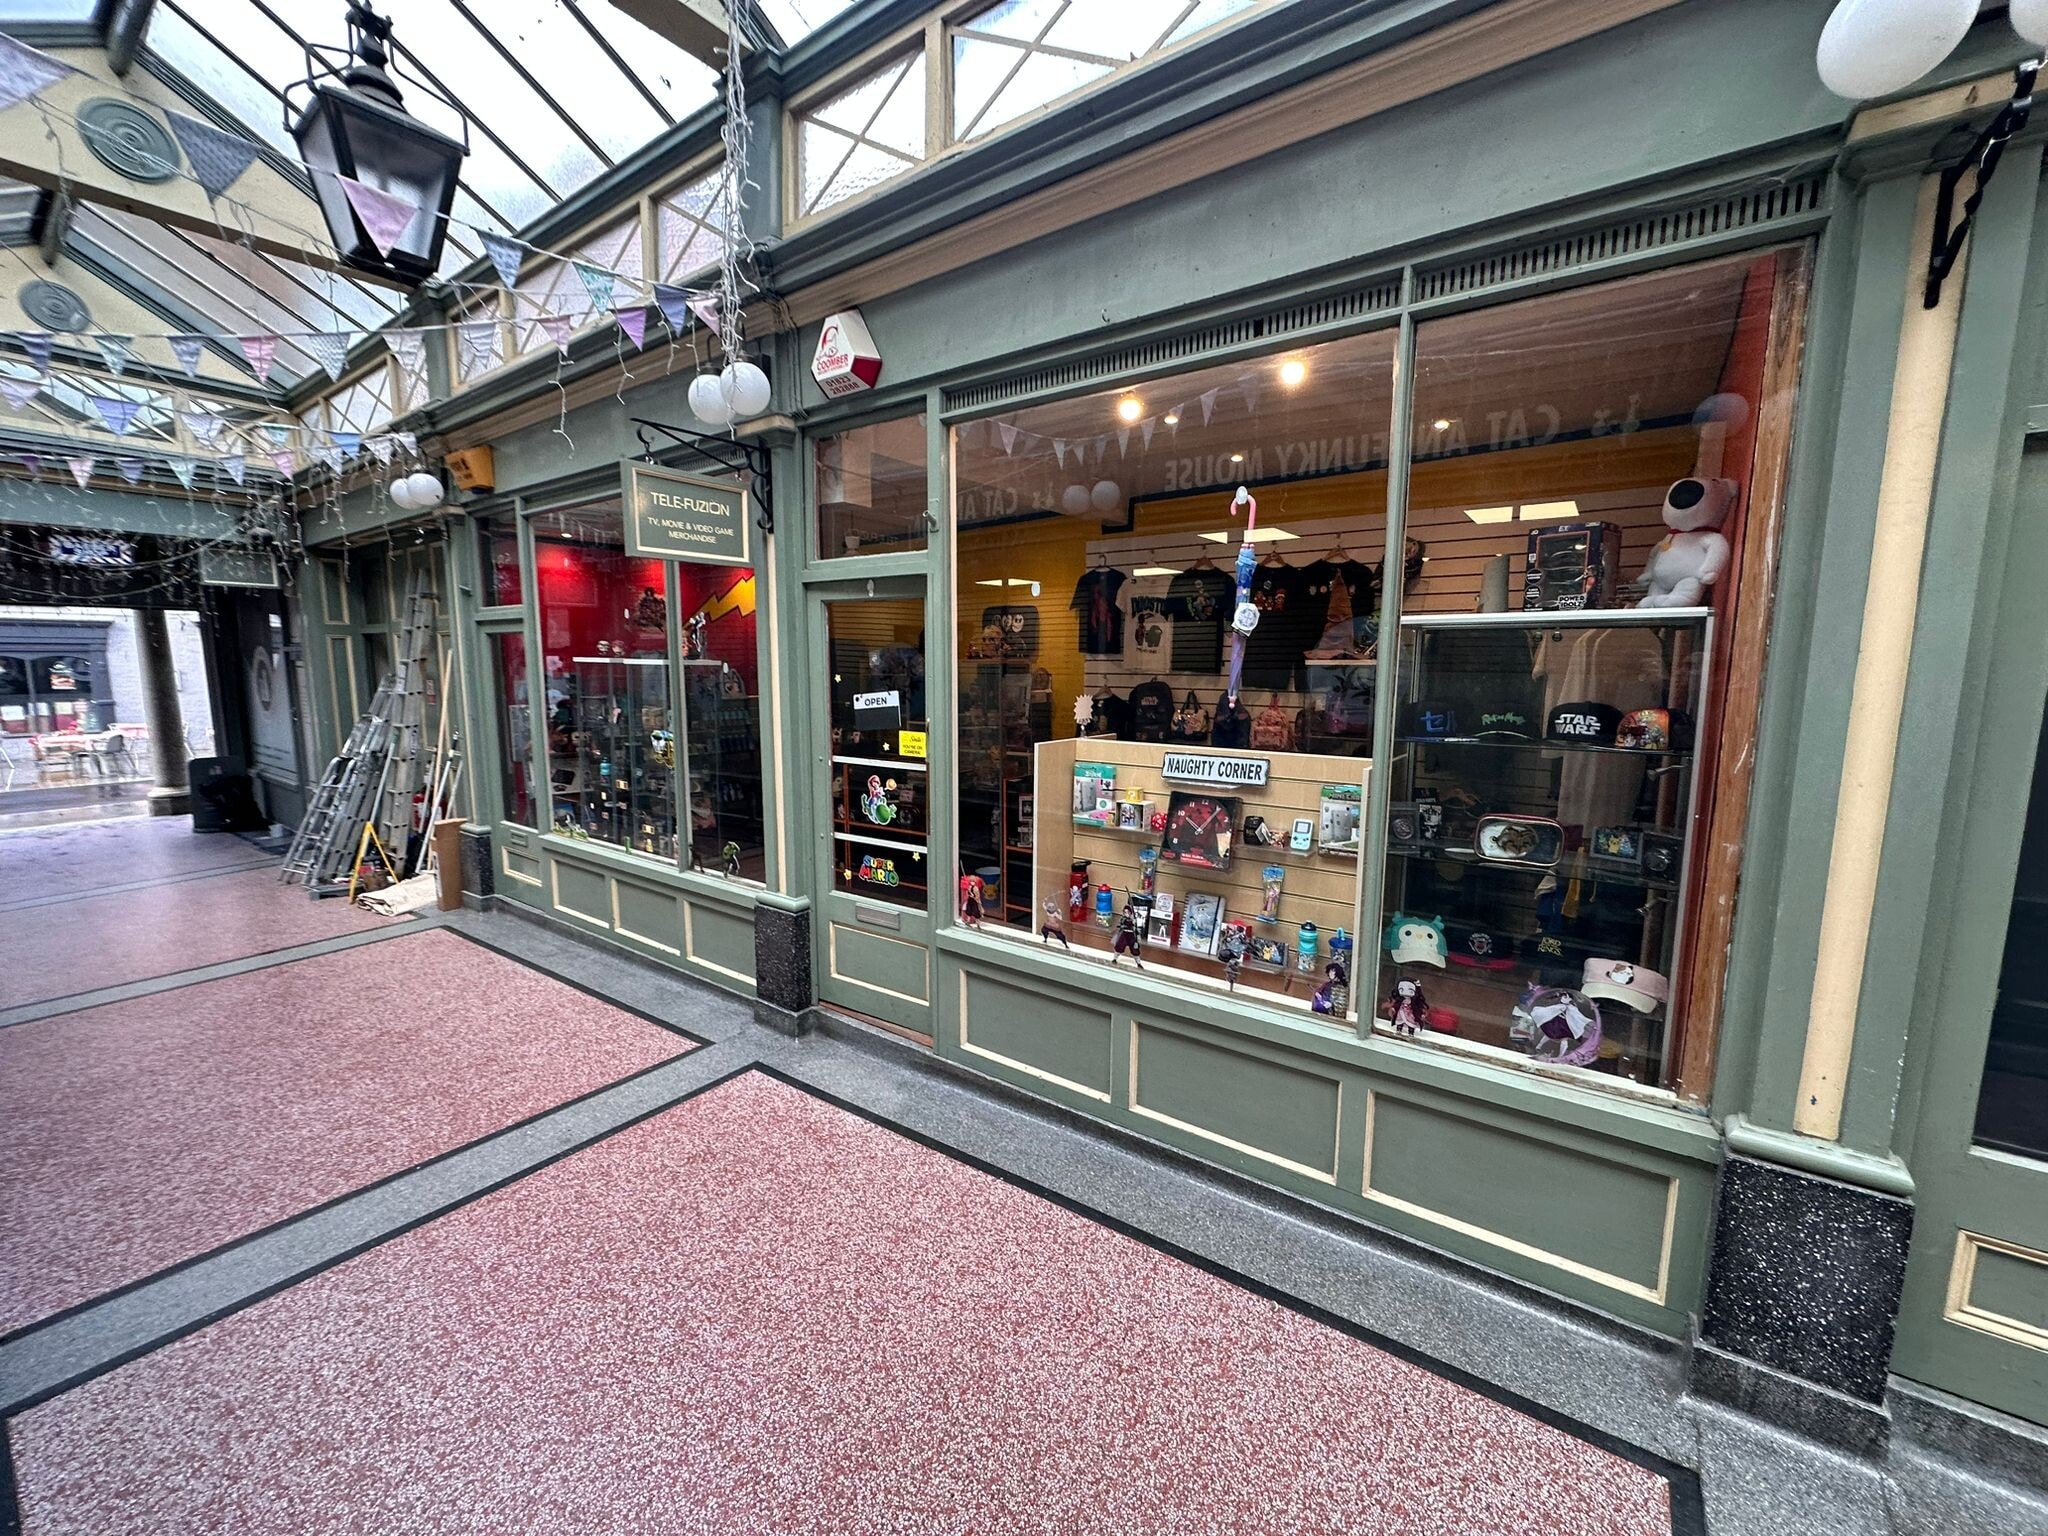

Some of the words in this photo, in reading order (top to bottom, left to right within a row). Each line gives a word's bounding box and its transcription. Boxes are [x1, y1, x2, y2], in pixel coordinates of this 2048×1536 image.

[816, 354, 849, 371] COOMBER
[650, 491, 730, 517] TELE-FUZION
[662, 519, 685, 530] MOVIE
[686, 522, 692, 531] &
[692, 523, 714, 534] VIDEO
[715, 526, 734, 537] GAME
[668, 530, 717, 543] MERCHANDISE
[864, 696, 888, 707] OPEN
[1555, 713, 1600, 726] STAR
[1555, 722, 1601, 735] WARS
[1167, 757, 1215, 776] NAUGHTY
[1217, 761, 1262, 781] CORNER
[863, 855, 894, 871] SUPER
[859, 864, 899, 887] MARIO
